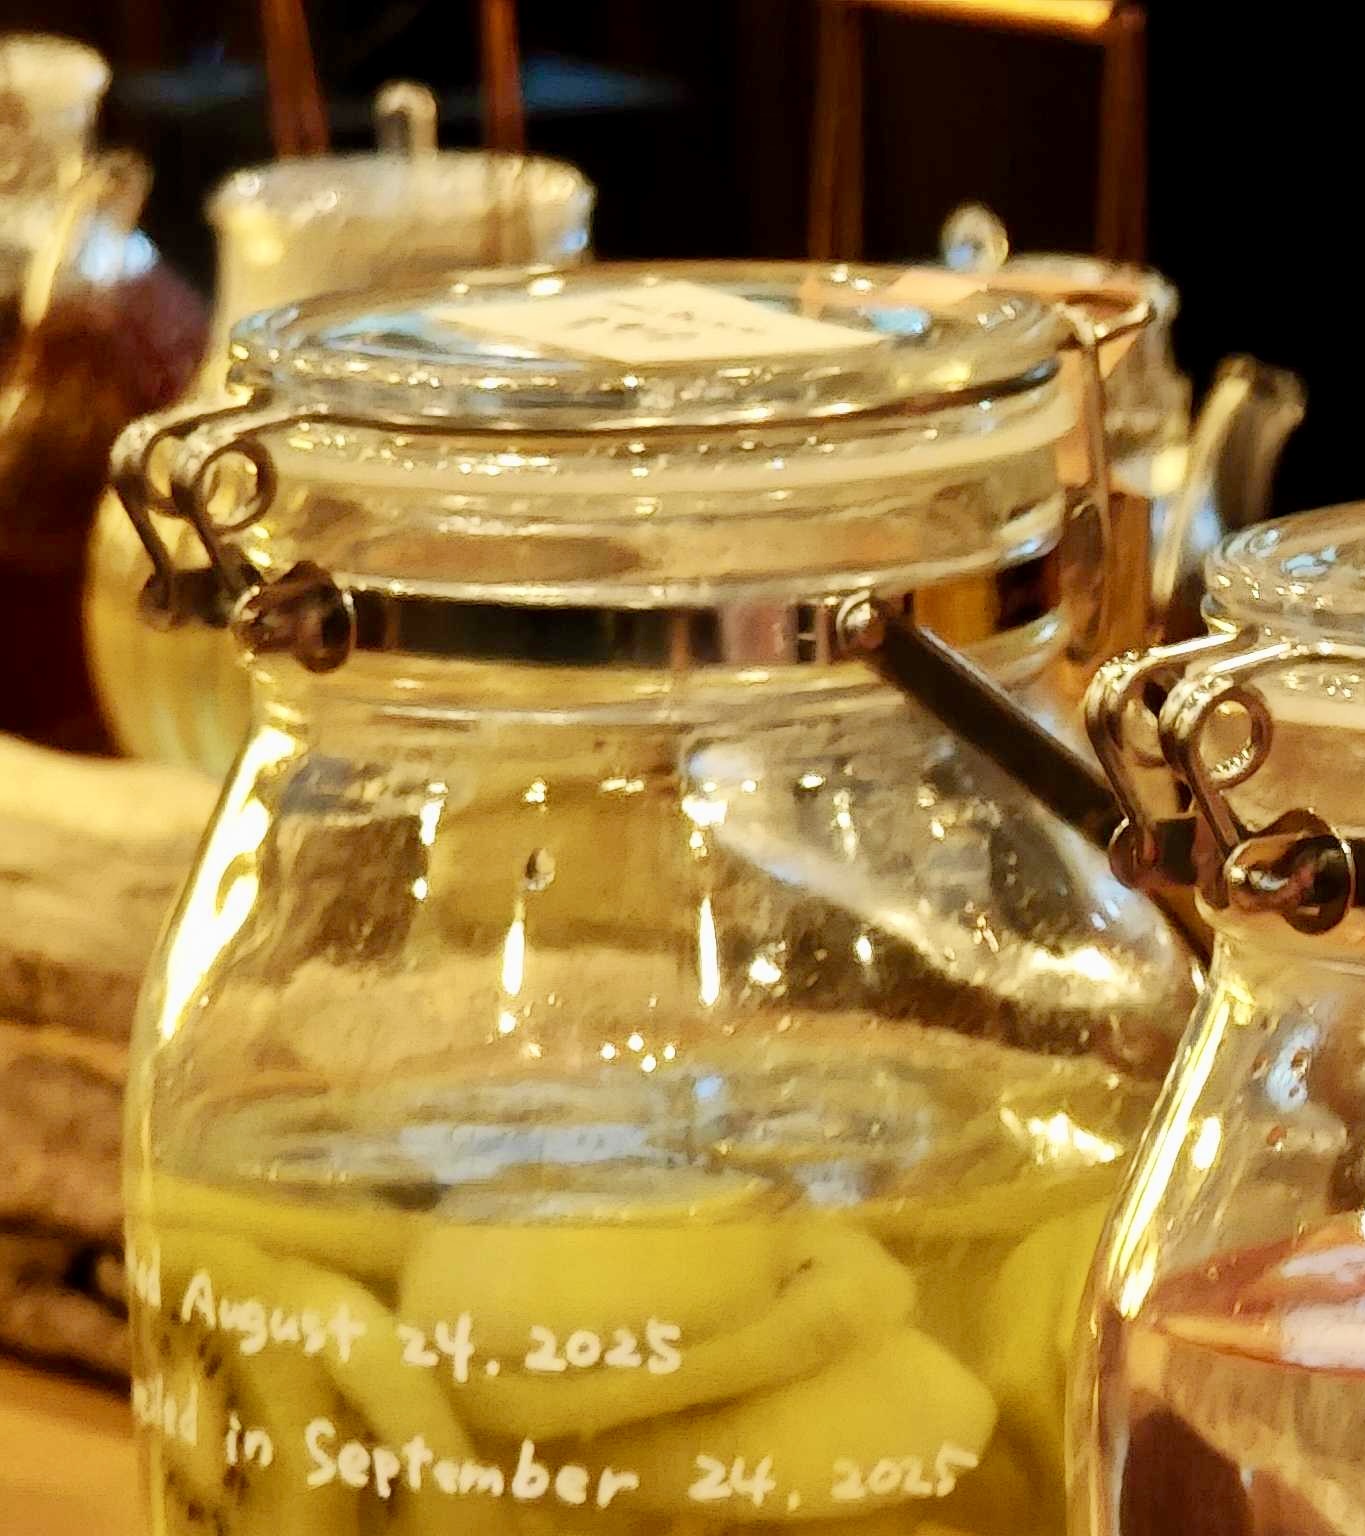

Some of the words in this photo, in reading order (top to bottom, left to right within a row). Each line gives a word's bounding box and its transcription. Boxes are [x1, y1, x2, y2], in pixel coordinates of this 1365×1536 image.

[181, 1267, 367, 1364] August
[526, 1319, 683, 1375] 2025
[226, 1412, 273, 1467] in
[304, 1418, 640, 1510] September
[832, 1443, 979, 1499] 2025
